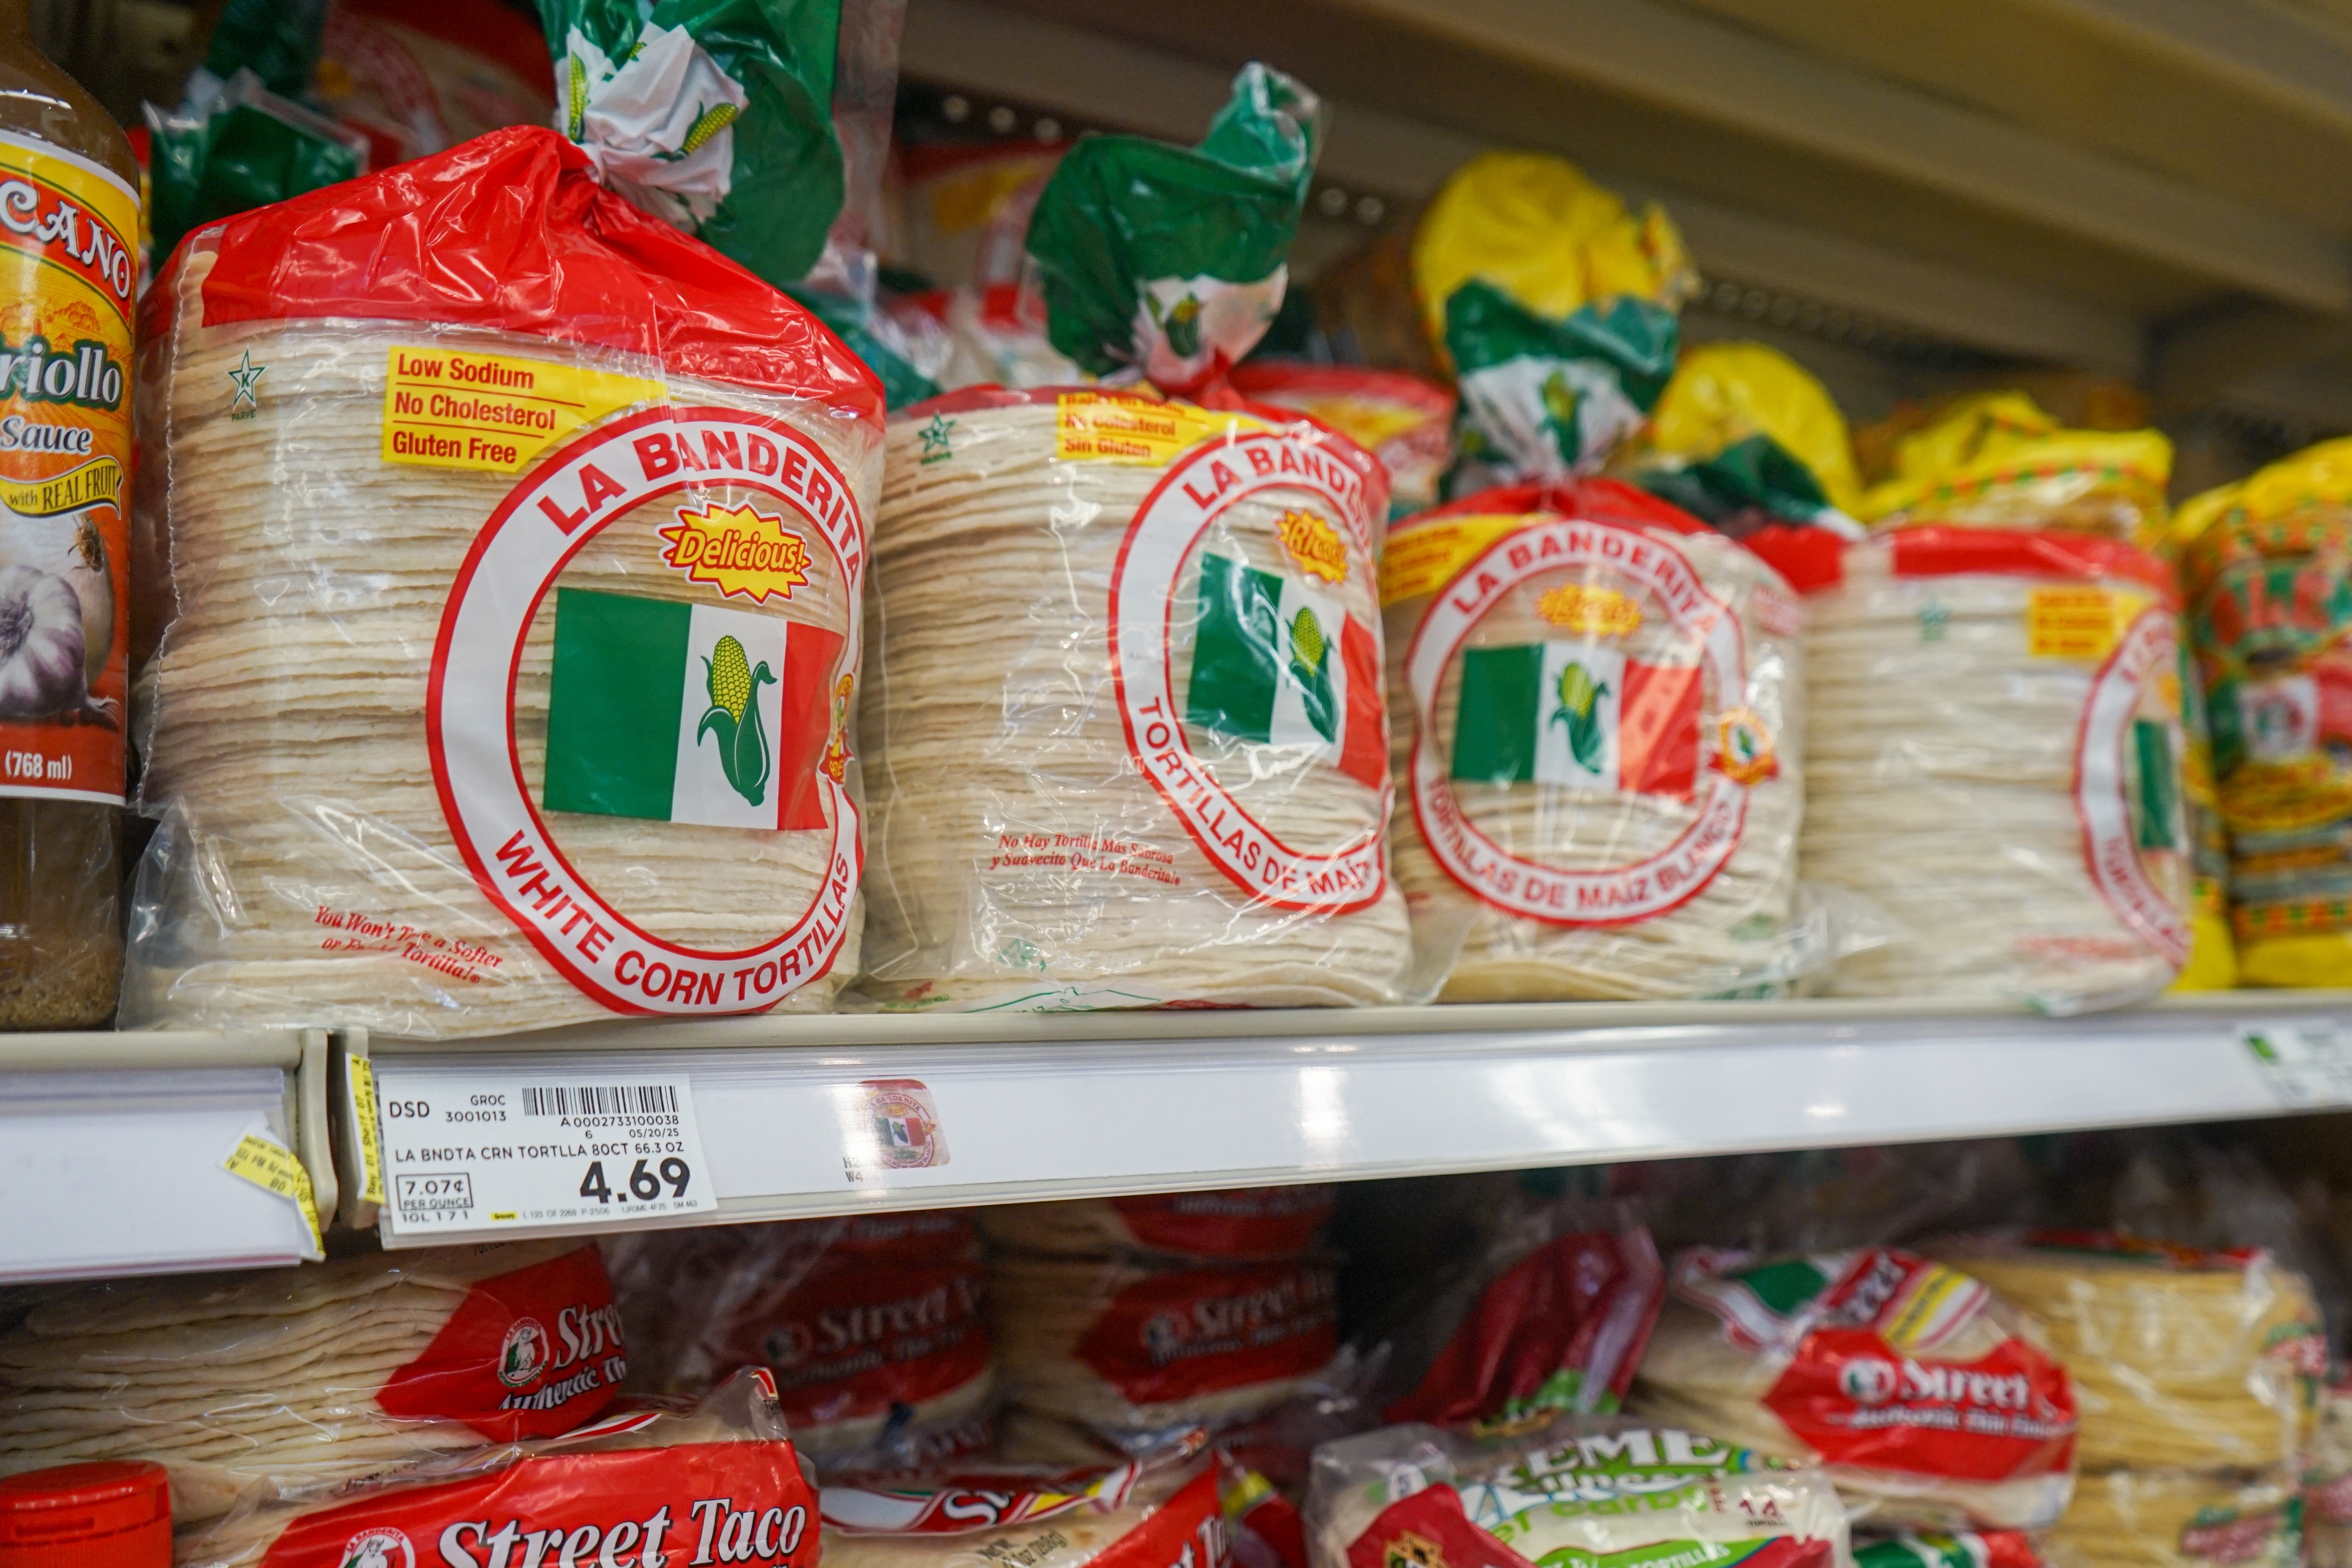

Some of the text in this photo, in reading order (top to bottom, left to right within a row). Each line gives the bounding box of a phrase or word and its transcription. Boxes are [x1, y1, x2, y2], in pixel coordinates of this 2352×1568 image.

[241, 373, 250, 388] K
[397, 353, 534, 389] Low Sodium
[232, 409, 256, 421] PARVE
[394, 391, 556, 431] No Cholesterol
[1, 417, 91, 453] Sauce
[393, 431, 517, 464] Gluten Free
[1064, 437, 1151, 458] Sin Gluten
[9, 465, 118, 513] with REAL FRUIT
[1182, 460, 1243, 510] LA
[537, 430, 861, 589] LA BANDERITA
[675, 529, 806, 574] Delicious!
[1452, 573, 1500, 616] LA
[1508, 529, 1717, 634] BANDERITA
[5, 751, 73, 781] (768 ml)
[1139, 697, 1262, 871] TORTILLAS
[1261, 856, 1301, 895] DE
[999, 835, 1019, 849] No
[1023, 833, 1051, 851] Hay
[1054, 832, 1098, 852] Tortilla
[989, 856, 1000, 871] y
[1070, 852, 1097, 871] Que
[1099, 859, 1116, 872] La
[1523, 876, 1564, 909] DE
[496, 829, 850, 1005] WHITE CORN TORTILLAS
[314, 905, 344, 928] You
[345, 912, 395, 940] Won't
[433, 938, 448, 948] a
[447, 939, 503, 968] Softer
[389, 1100, 430, 1118] DSD
[445, 1110, 506, 1123] 3001013
[470, 1094, 506, 1106] GROC
[584, 1128, 679, 1139] 6 05/20/25
[395, 1148, 416, 1163] LA
[421, 1147, 477, 1163] BNDTA
[481, 1147, 513, 1161] CRN
[518, 1143, 588, 1160] TORTLLA
[635, 1142, 662, 1155] 66.3
[665, 1141, 684, 1153] OZ
[405, 1178, 465, 1196] 7.07¢
[580, 1157, 691, 1203] 4.69
[403, 1197, 471, 1209] PER OUNCE
[448, 1211, 457, 1221] 7
[1900, 1358, 2030, 1411] Street
[439, 1497, 806, 1568] Street Taco
